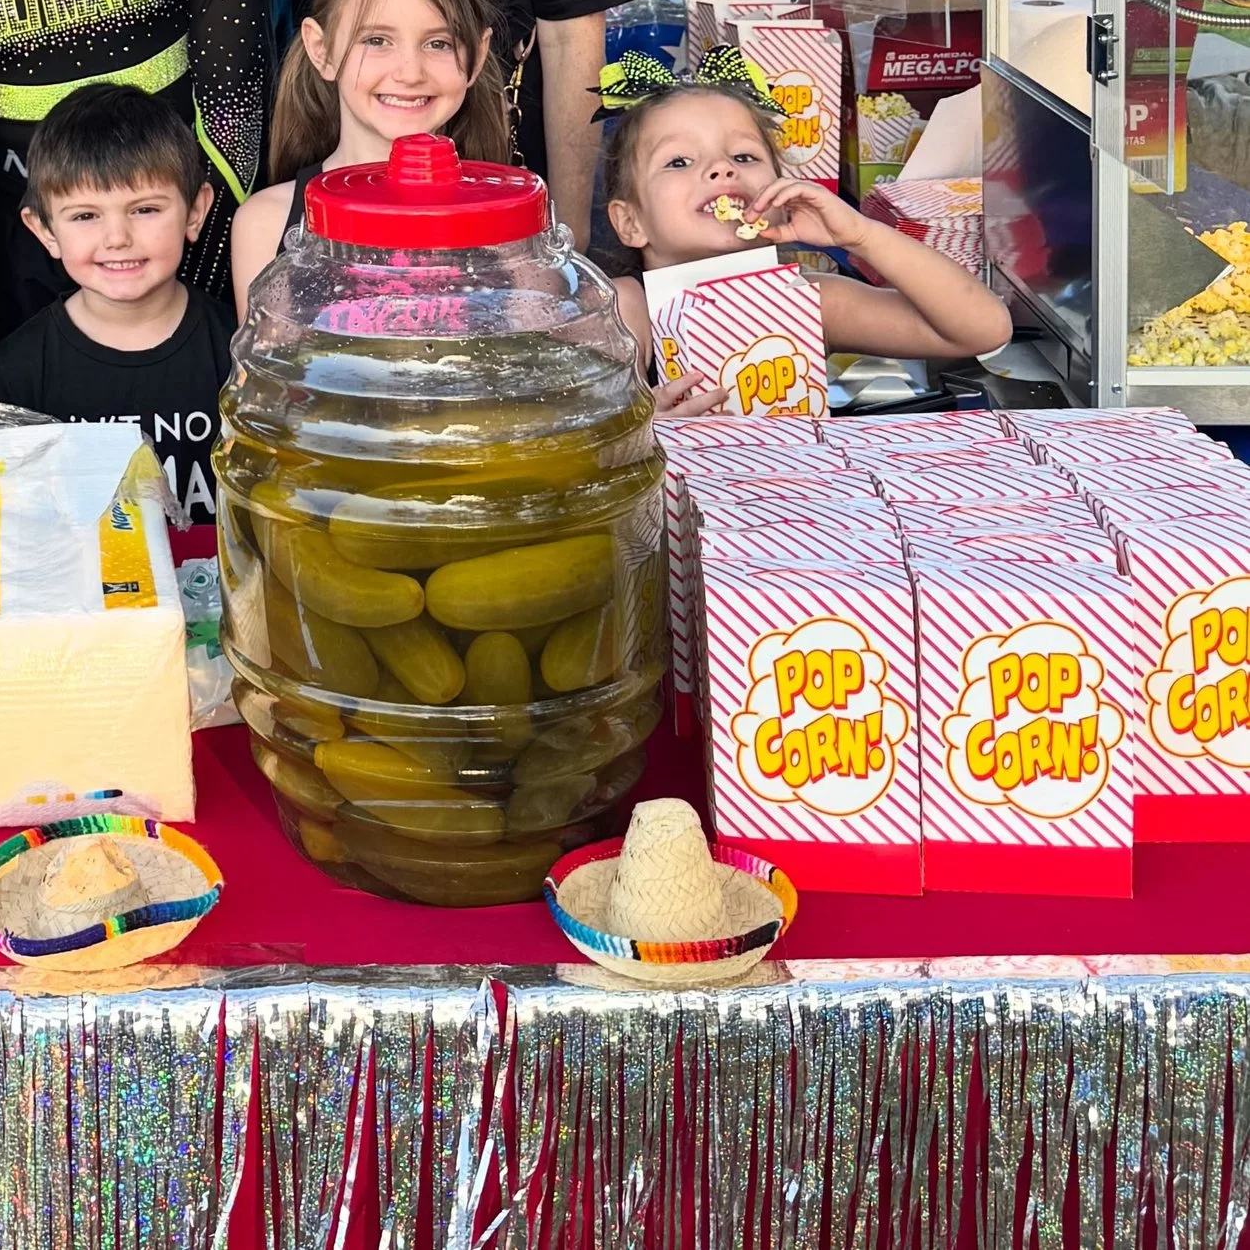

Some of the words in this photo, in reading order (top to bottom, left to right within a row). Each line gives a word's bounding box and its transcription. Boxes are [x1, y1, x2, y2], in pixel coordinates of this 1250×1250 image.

[735, 355, 797, 415] POP
[154, 411, 212, 442] NO
[1190, 607, 1250, 675] PO
[773, 649, 865, 718] POP
[988, 652, 1081, 720] POP
[1167, 669, 1250, 743] COR
[754, 710, 886, 788] CORN!
[966, 714, 1099, 790] CORN!
